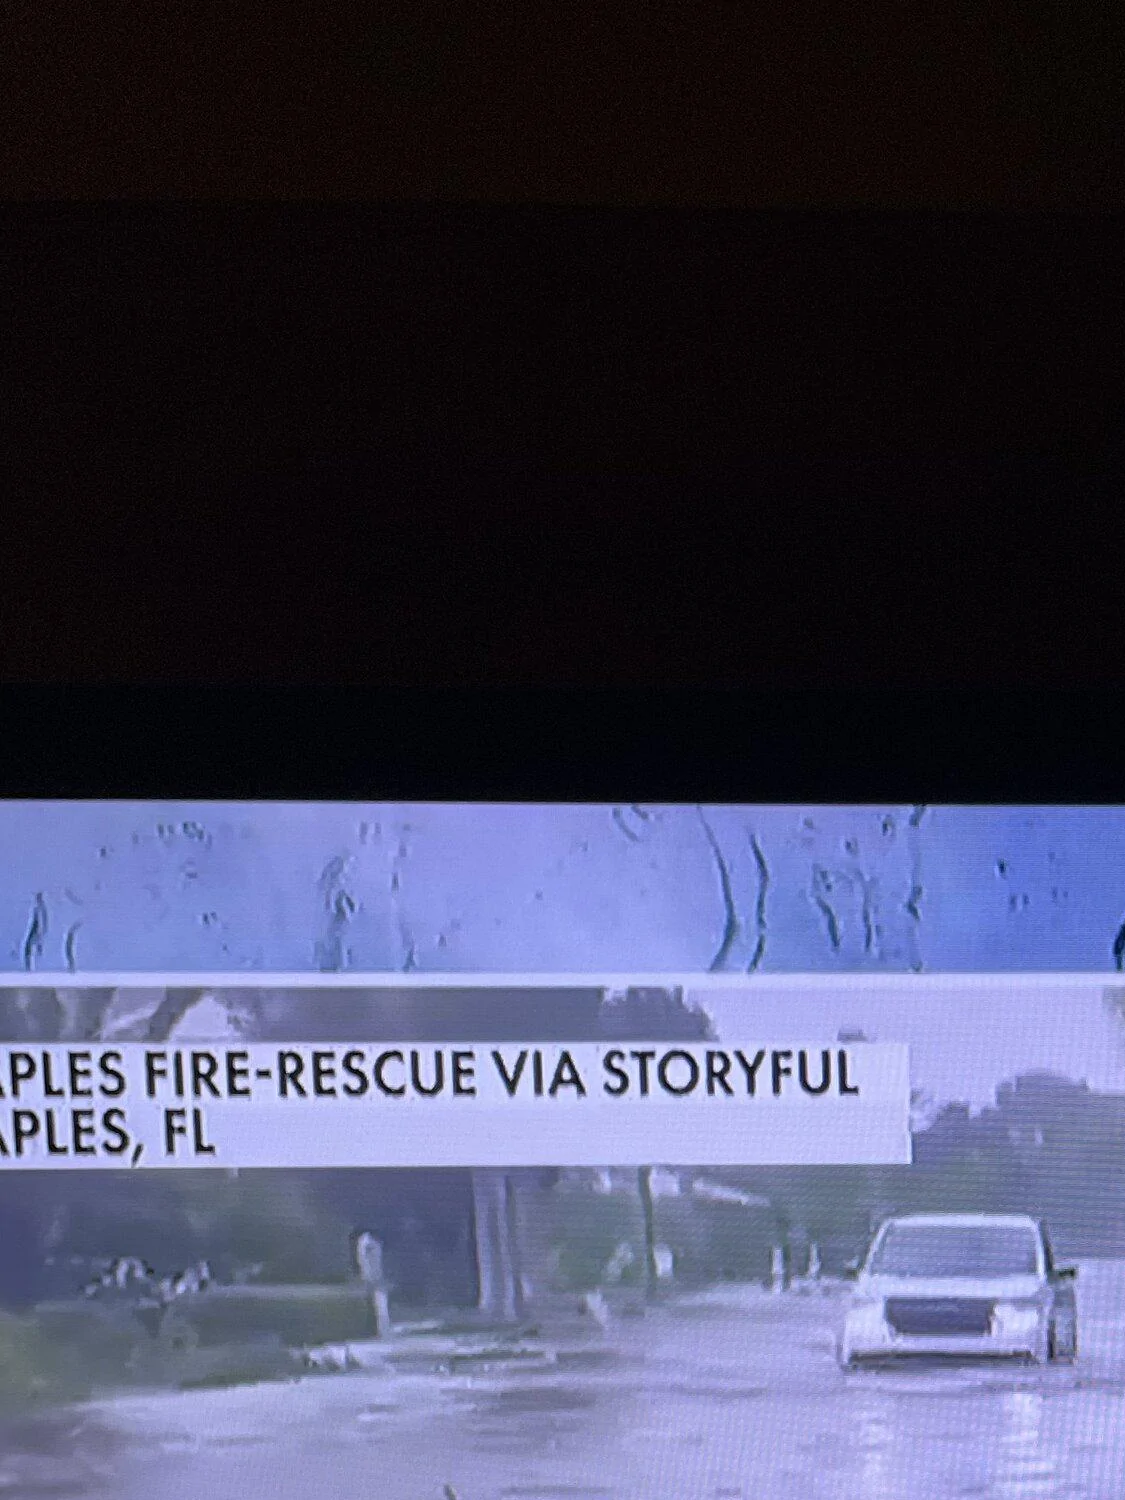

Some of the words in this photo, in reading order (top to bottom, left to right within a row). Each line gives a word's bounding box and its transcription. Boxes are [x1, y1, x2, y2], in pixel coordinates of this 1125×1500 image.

[0, 1051, 126, 1097] PLES
[146, 1050, 476, 1097] FIRE-RESCUE
[493, 1050, 589, 1094] VIA
[604, 1050, 860, 1096] STORYFUL
[0, 1110, 144, 1165] PLES,
[165, 1109, 216, 1155] FL
